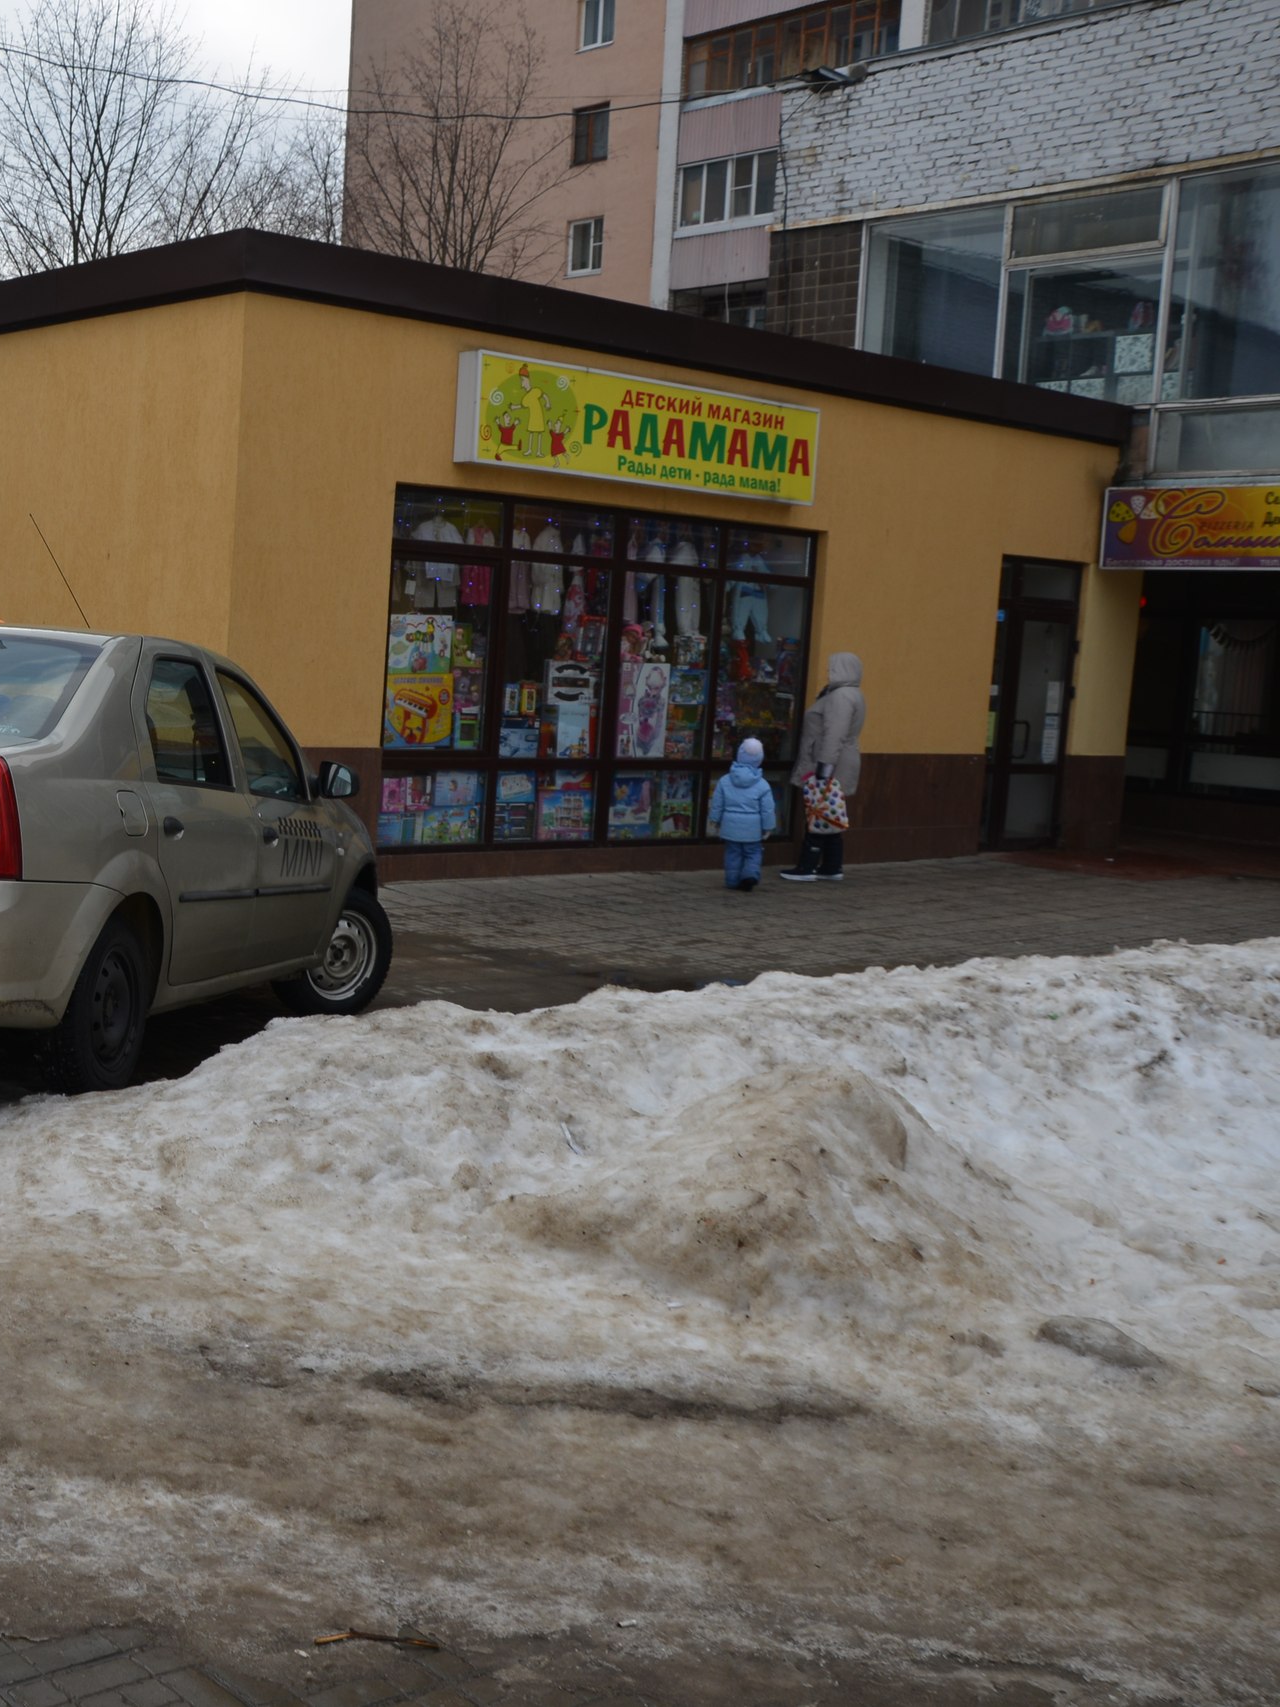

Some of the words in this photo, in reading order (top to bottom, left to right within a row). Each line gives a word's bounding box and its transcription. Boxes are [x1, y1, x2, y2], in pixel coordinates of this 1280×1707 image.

[621, 389, 703, 417] ДЕТСКИЙ
[707, 403, 785, 430] МАГАЗИН
[583, 403, 810, 477] РАДАМАМА
[617, 455, 657, 477] Рады
[660, 463, 692, 481] дети
[703, 471, 735, 487] рада
[739, 477, 781, 493] мама!
[280, 839, 323, 877] MINI
